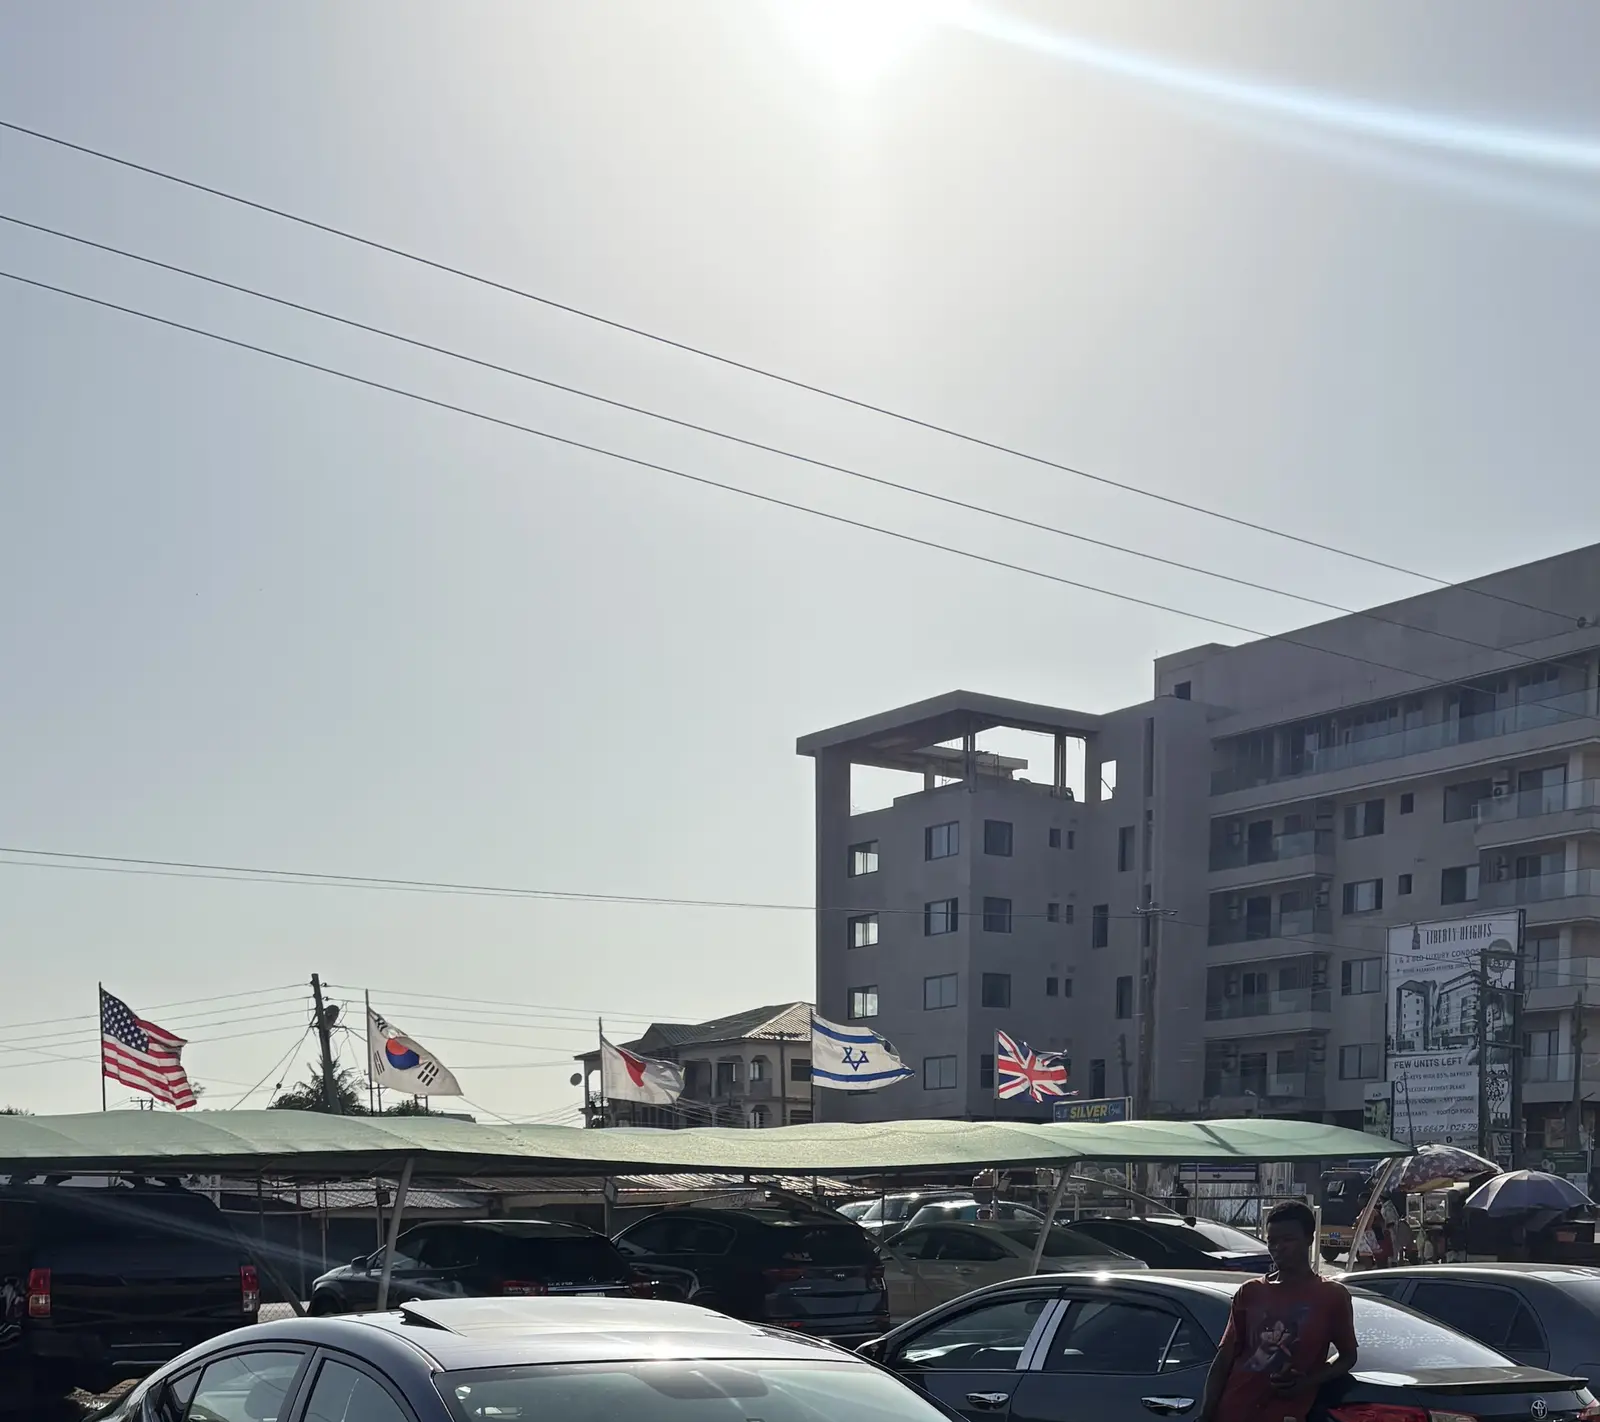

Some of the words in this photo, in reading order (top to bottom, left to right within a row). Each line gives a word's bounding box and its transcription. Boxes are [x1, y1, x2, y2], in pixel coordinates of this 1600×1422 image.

[1426, 928, 1456, 945] LIBERTY
[1460, 923, 1492, 940] HEIGHTS
[1425, 952, 1450, 960] LUXURY
[1451, 949, 1480, 958] CONDOS
[1394, 1061, 1411, 1069] FEW
[1414, 1059, 1439, 1068] UNITS
[1442, 1057, 1463, 1066] LEFT
[1070, 1105, 1108, 1119] SILVER
